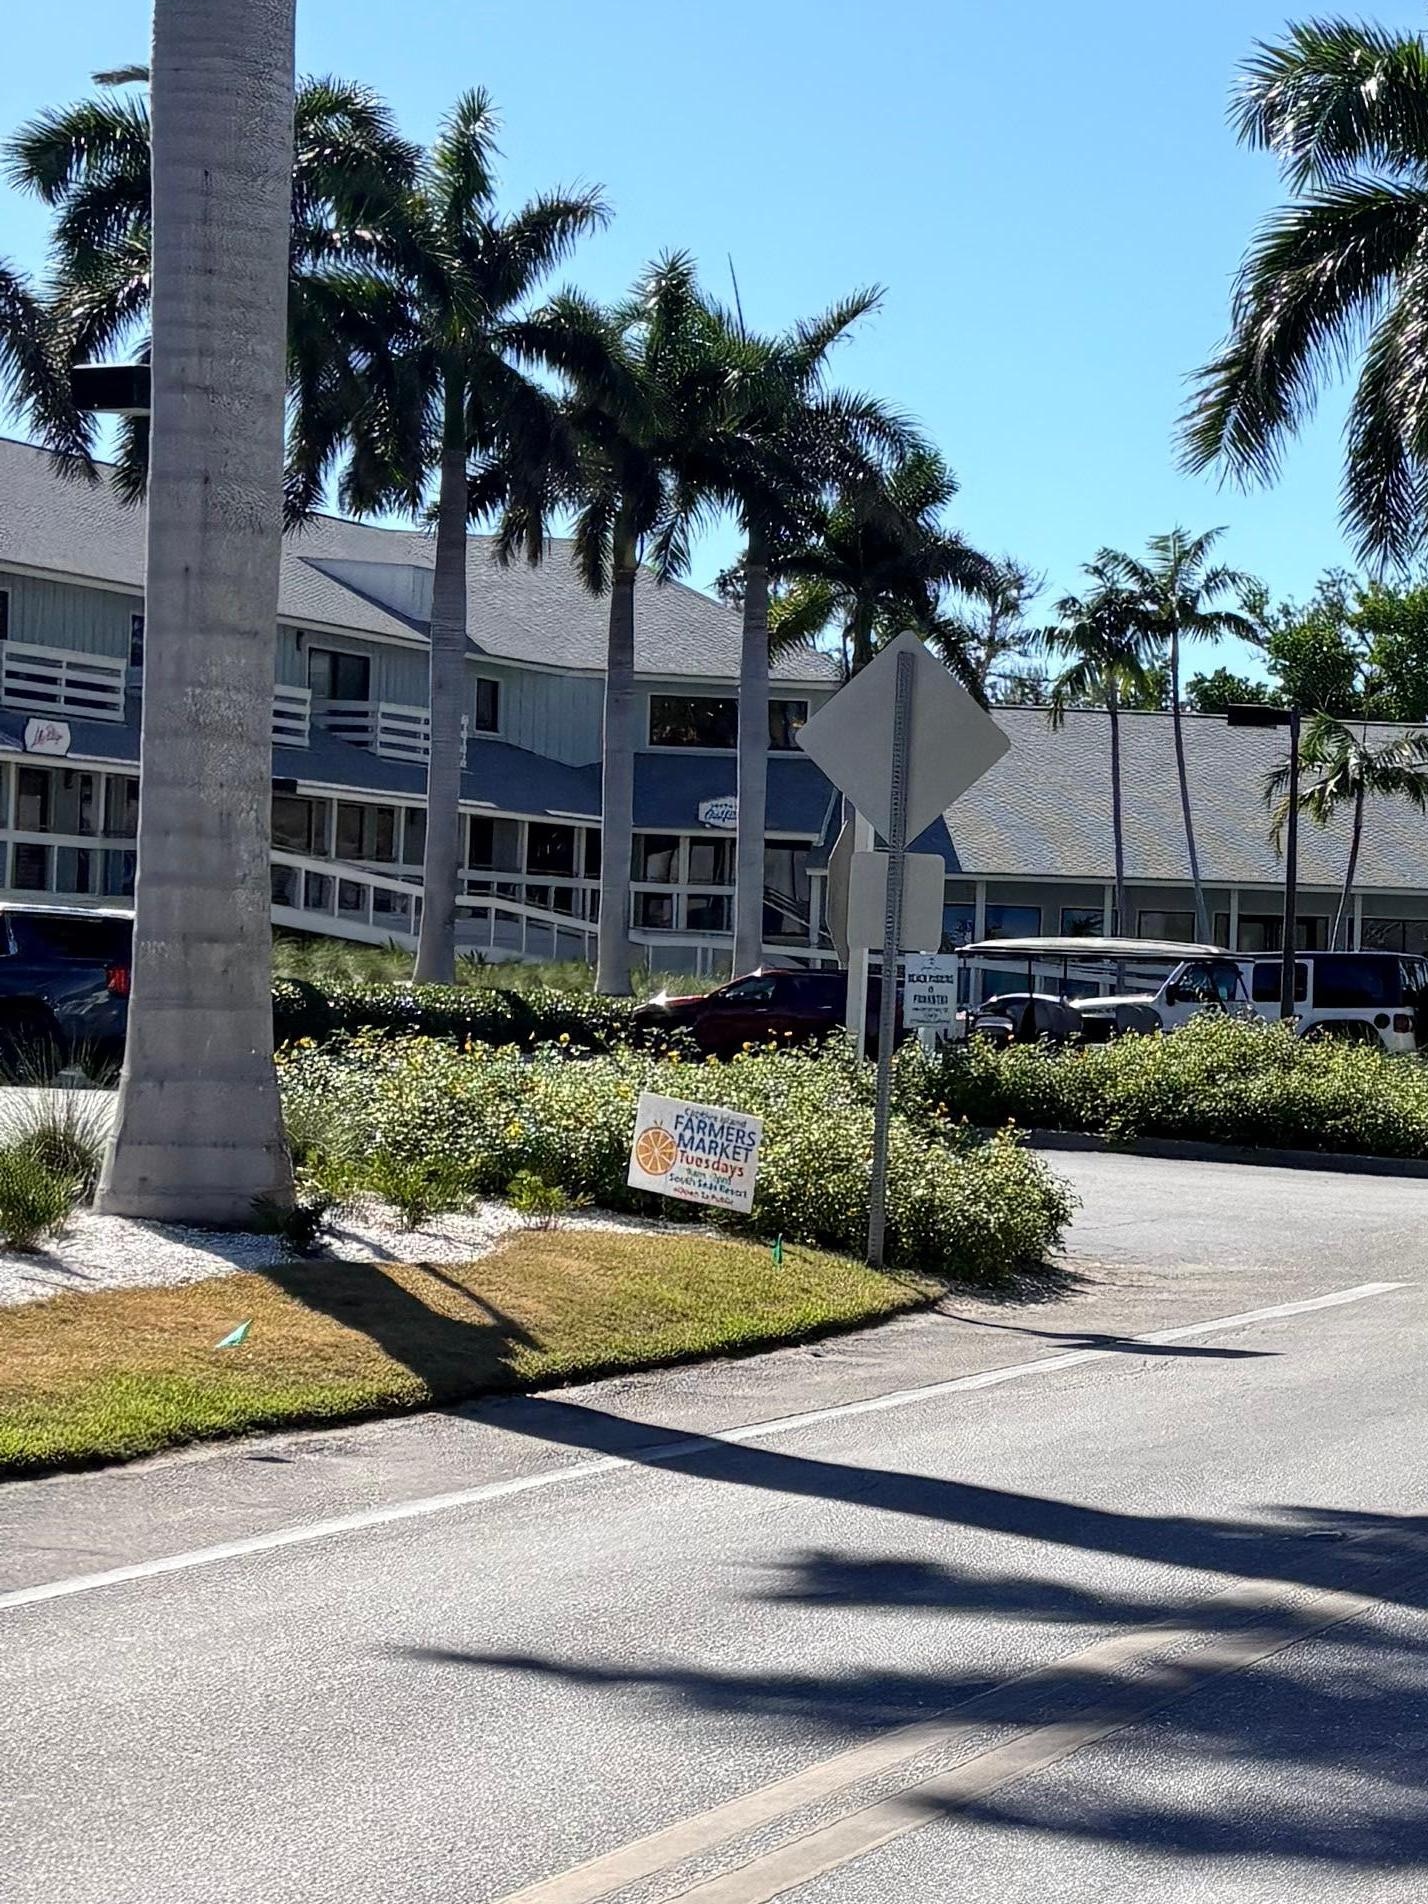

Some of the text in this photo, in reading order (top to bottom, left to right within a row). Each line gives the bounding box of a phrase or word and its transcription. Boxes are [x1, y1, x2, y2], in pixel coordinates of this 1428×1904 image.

[674, 1114, 757, 1147] FARMERS
[677, 1132, 753, 1163] MARKET
[680, 1150, 744, 1179] Tuesdays
